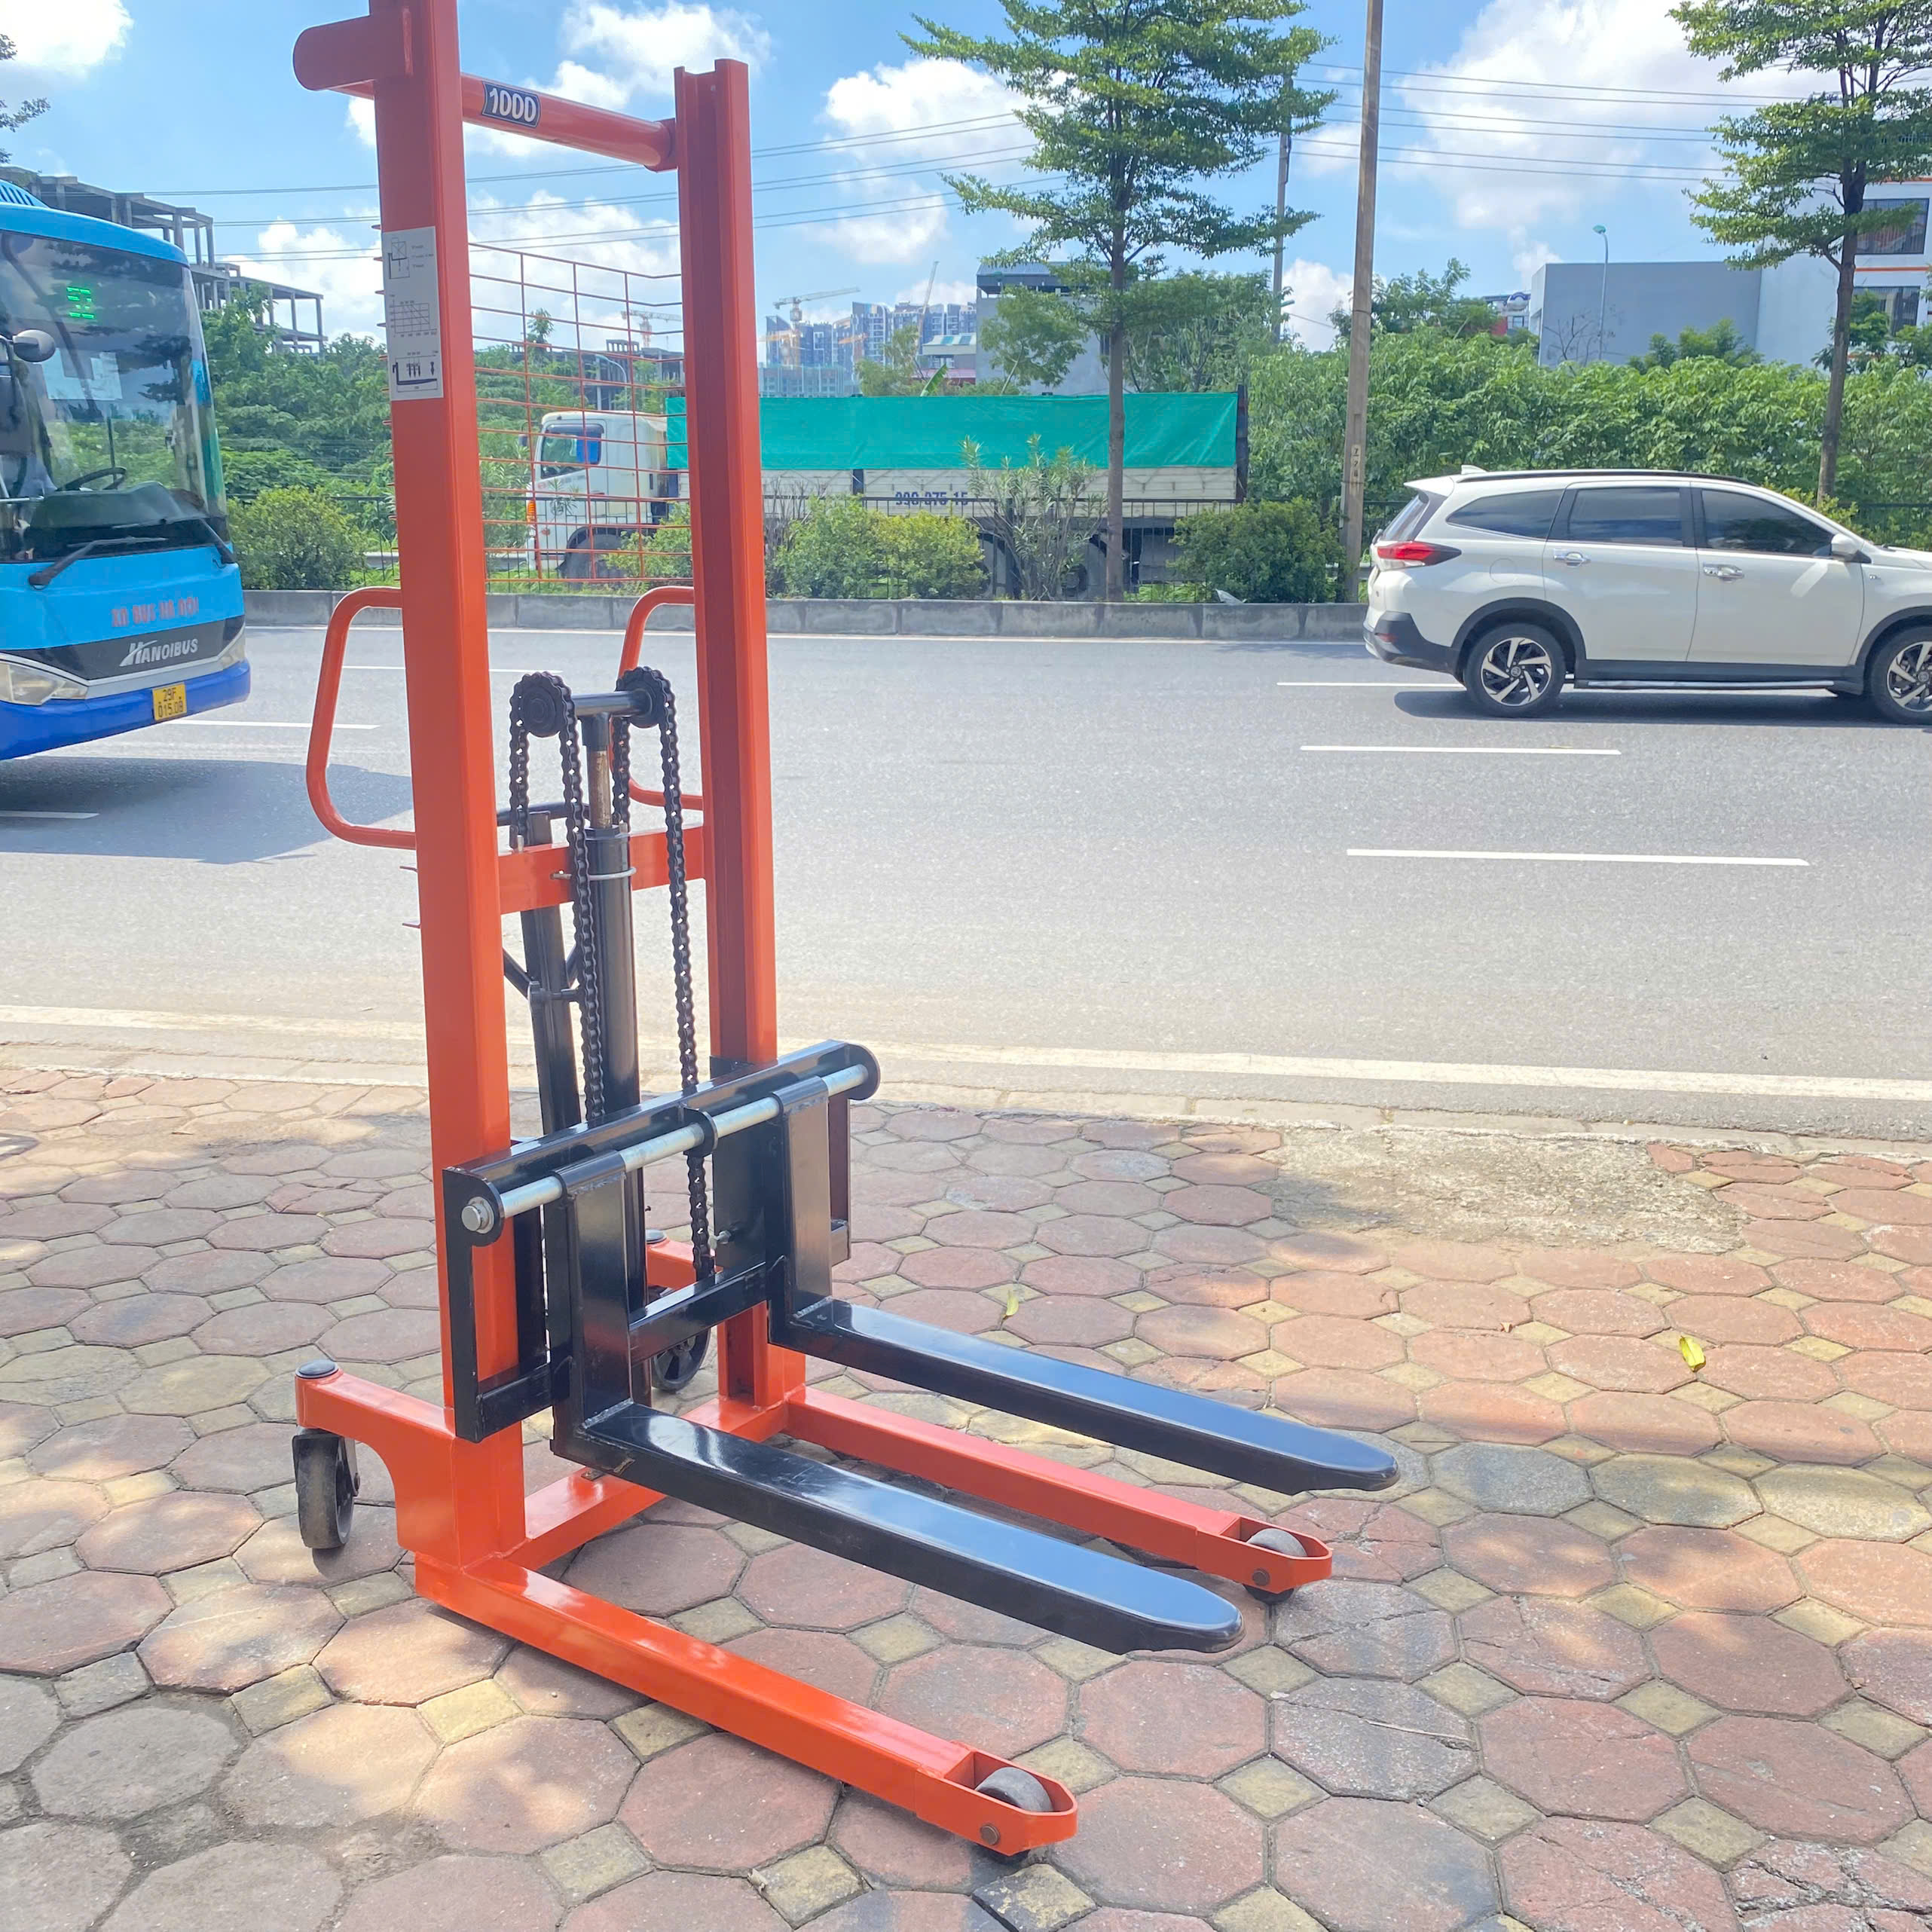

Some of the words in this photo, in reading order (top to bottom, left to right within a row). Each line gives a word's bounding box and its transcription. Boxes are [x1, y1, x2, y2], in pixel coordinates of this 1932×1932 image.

[489, 87, 536, 122] 1000
[120, 639, 198, 667] HANOIBUS
[163, 687, 176, 702] 29F
